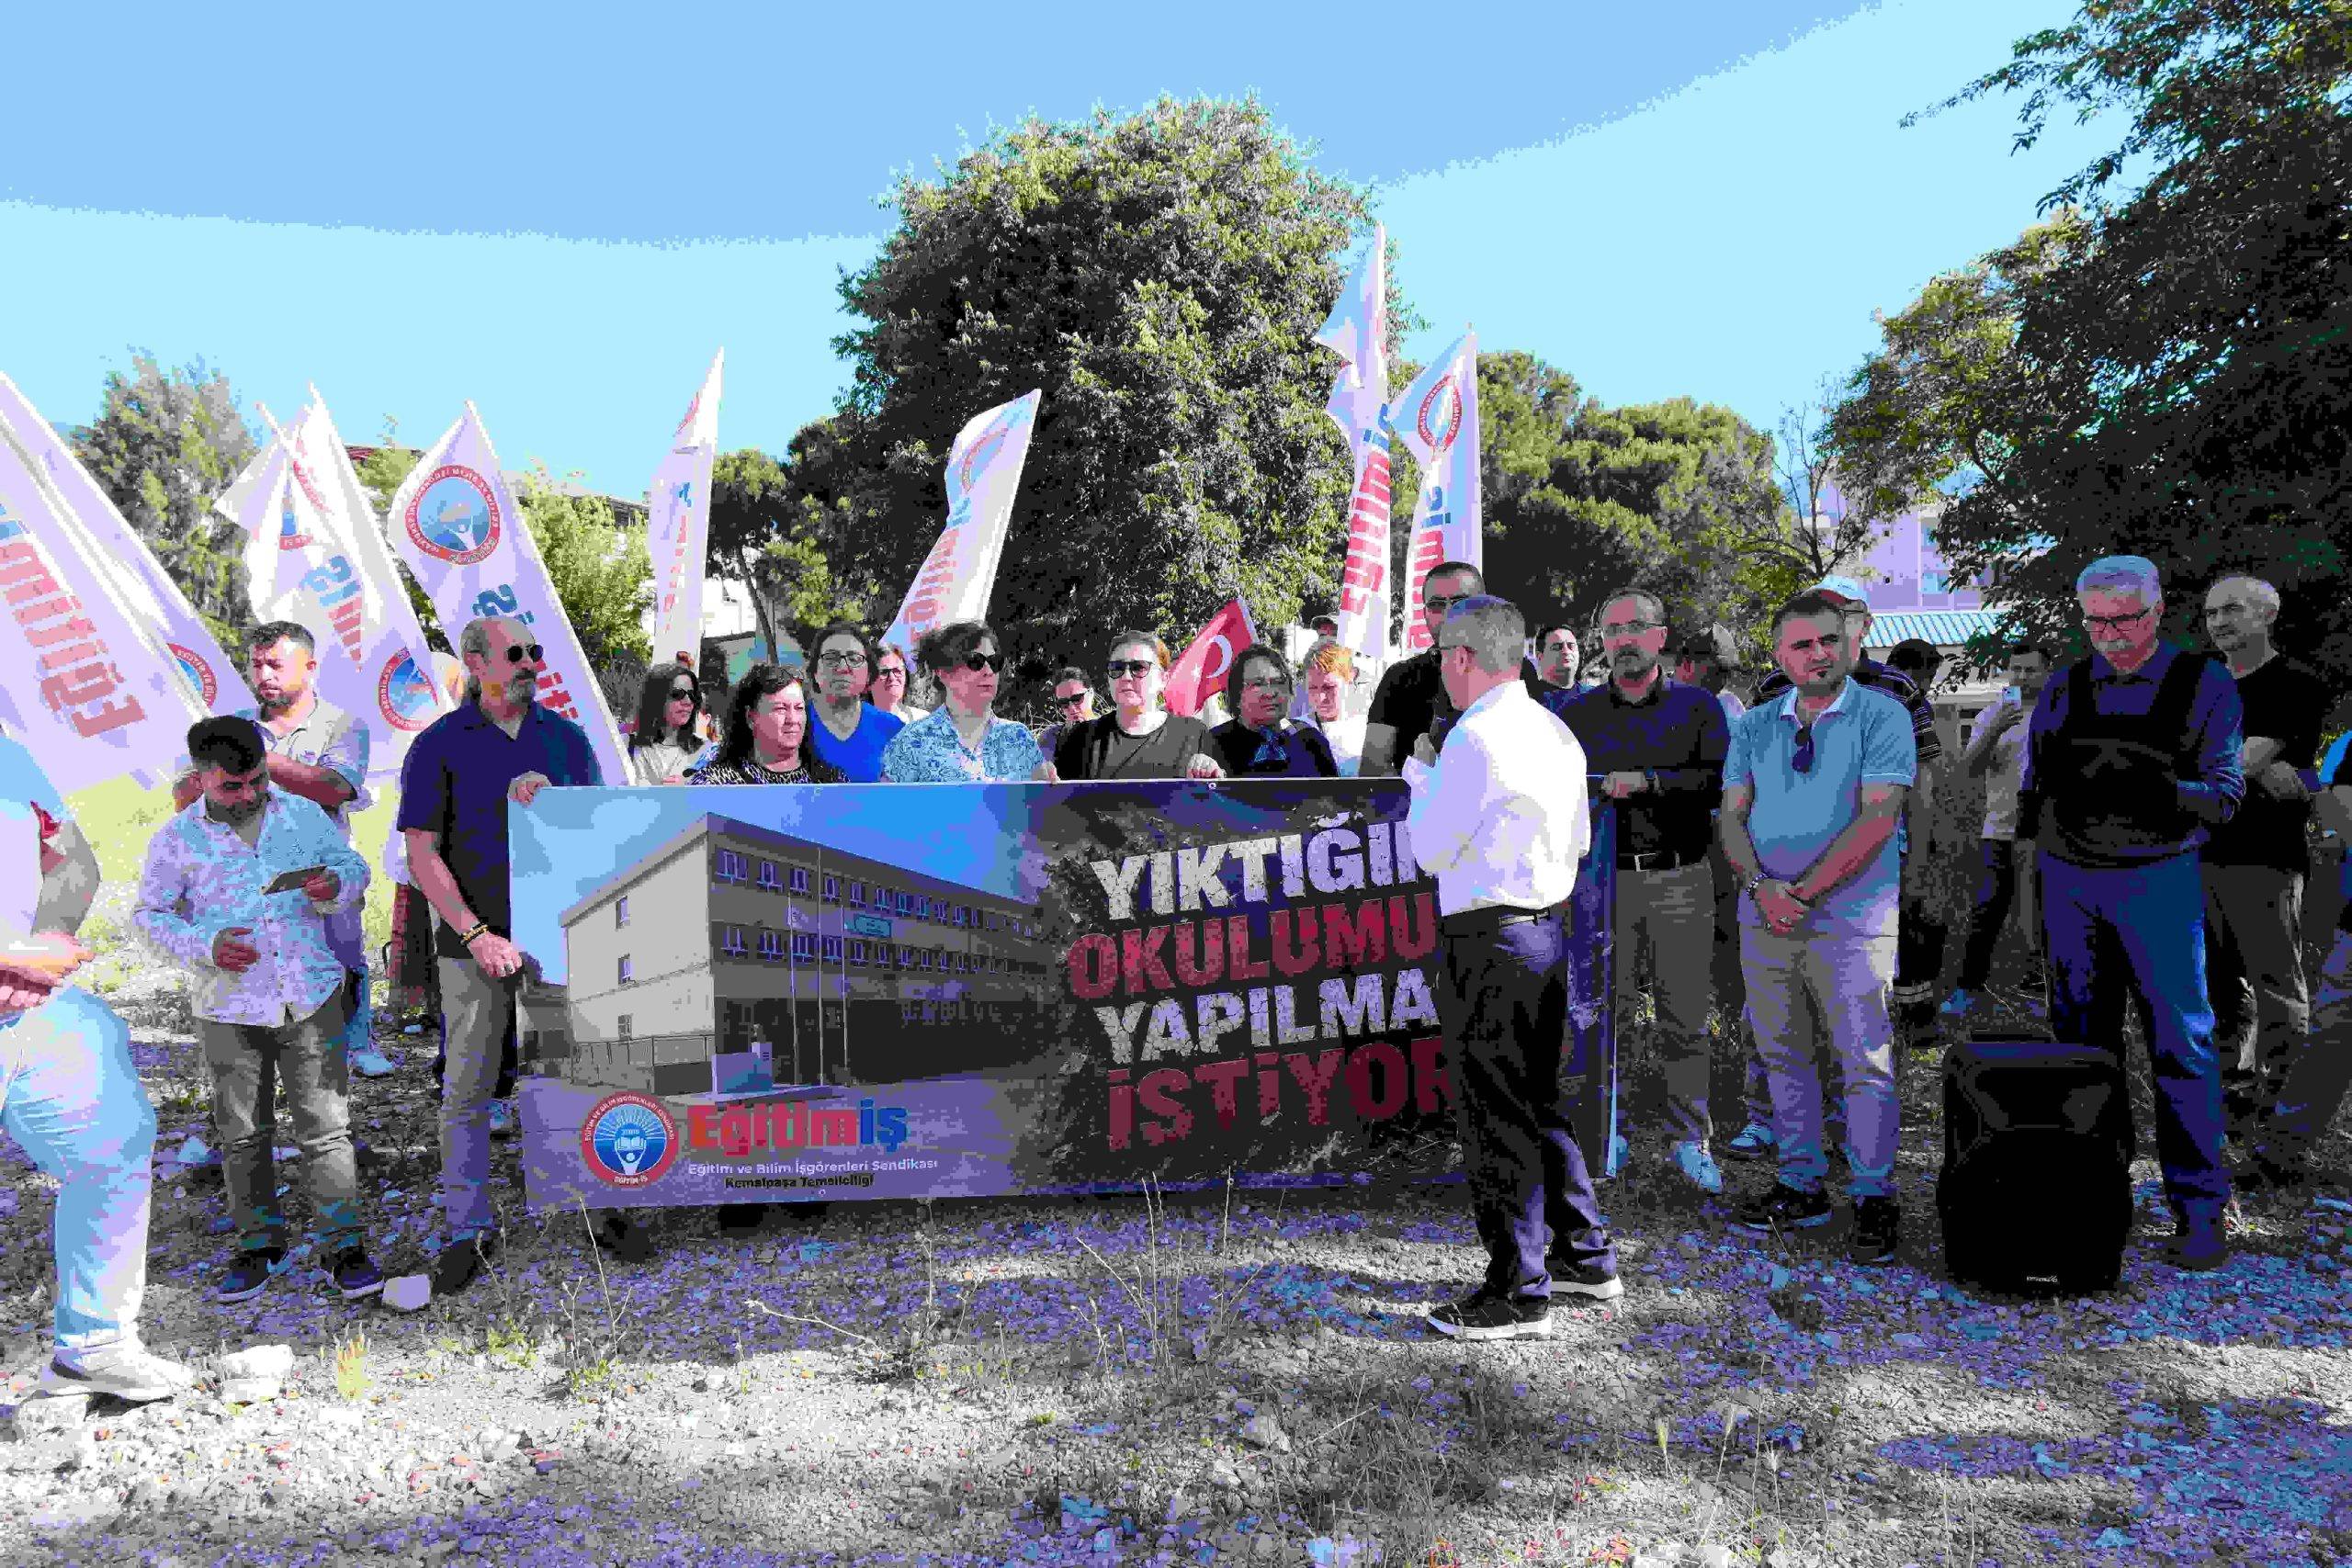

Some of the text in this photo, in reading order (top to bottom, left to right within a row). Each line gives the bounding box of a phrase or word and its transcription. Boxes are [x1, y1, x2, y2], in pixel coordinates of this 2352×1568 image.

[1068, 892, 1437, 998] OKULUMU
[1093, 967, 1441, 1065] YAPILMA
[688, 1157, 938, 1176] Eğitim ve Bilim İşgörenleri Sendikası
[725, 1177, 797, 1190] Kemalpaşa
